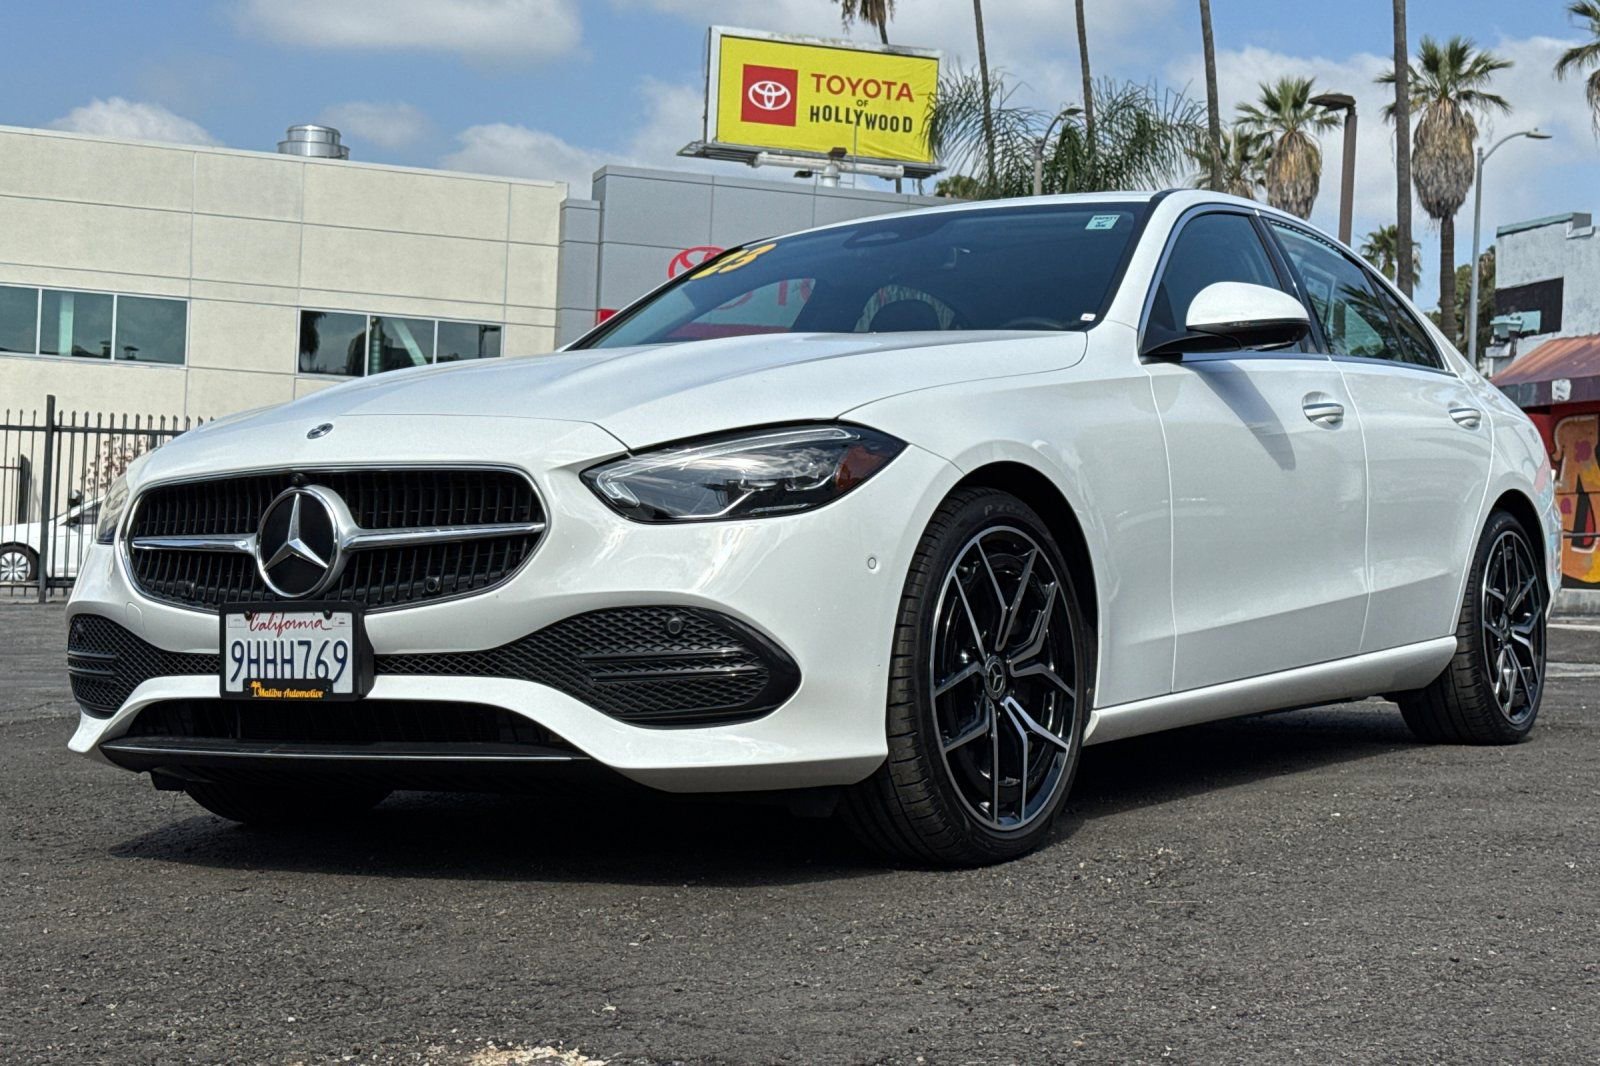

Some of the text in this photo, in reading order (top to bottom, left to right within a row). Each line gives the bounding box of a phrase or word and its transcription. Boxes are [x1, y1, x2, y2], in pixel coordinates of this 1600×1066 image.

[811, 73, 914, 102] TOYOTA
[856, 99, 869, 107] OF
[810, 105, 913, 133] HOLLYWOOD
[689, 243, 777, 280] 23
[249, 612, 332, 638] California
[230, 640, 348, 683] 9HHH769
[283, 688, 324, 698] Automotive
